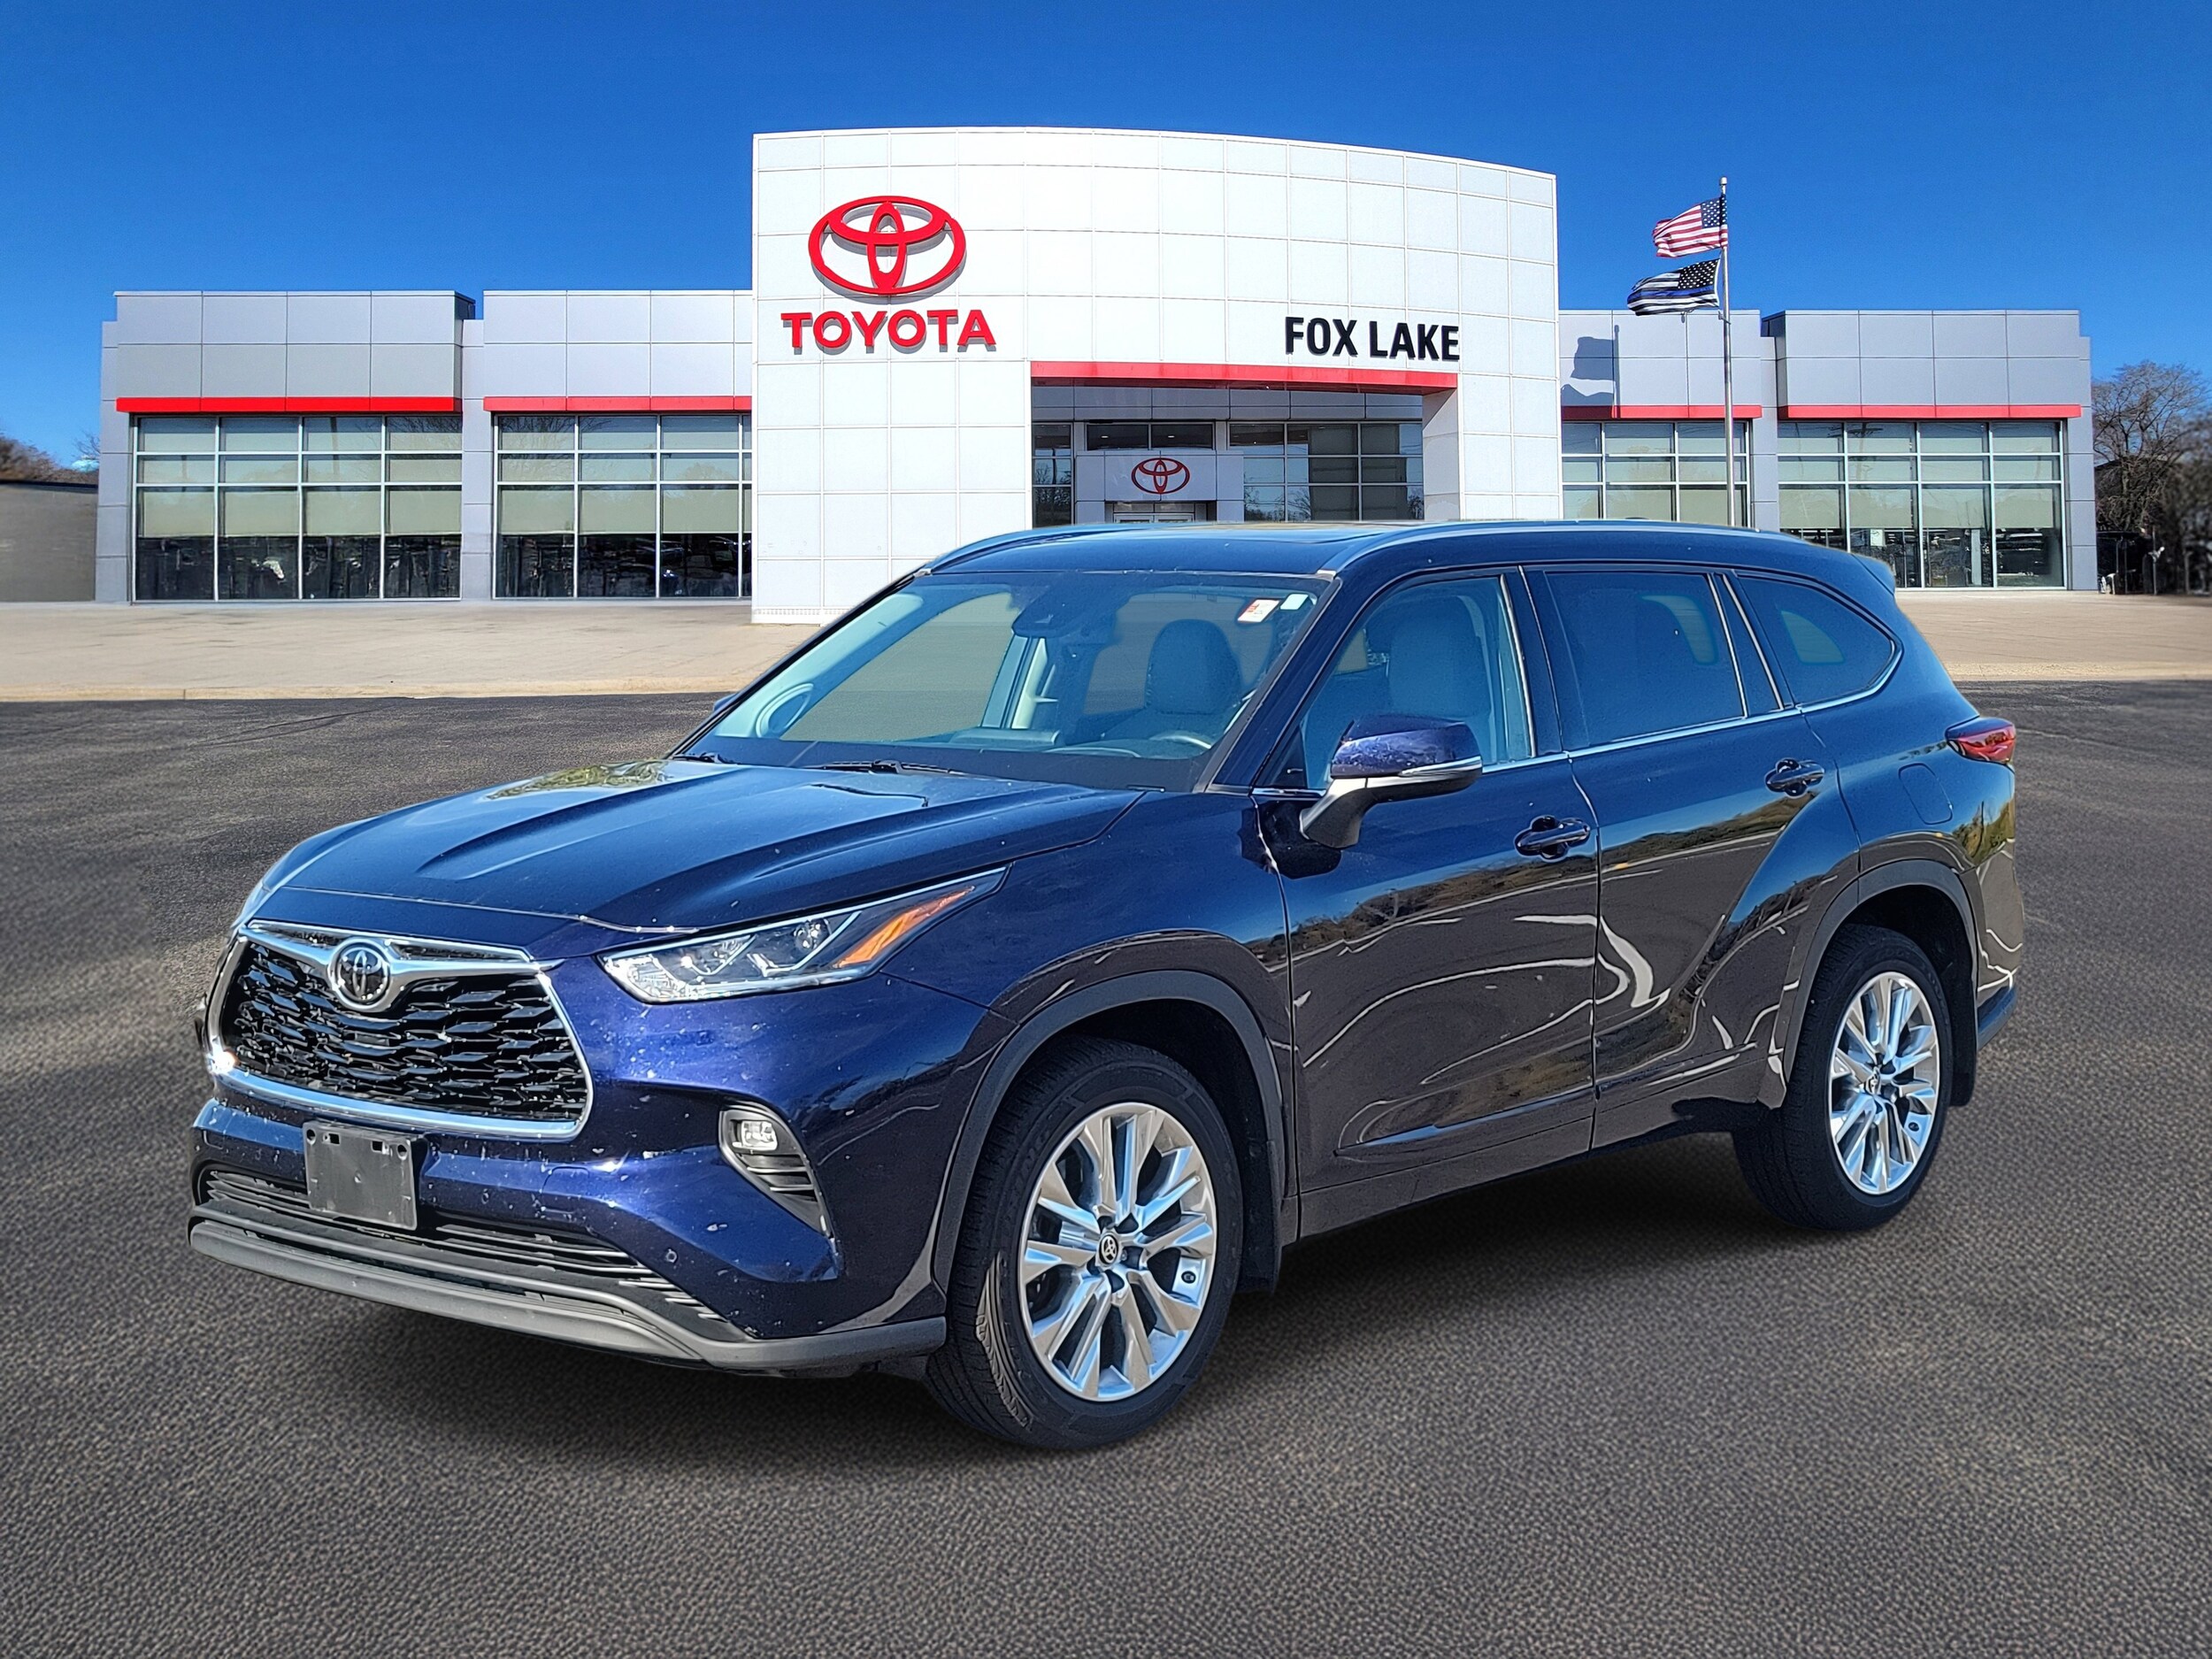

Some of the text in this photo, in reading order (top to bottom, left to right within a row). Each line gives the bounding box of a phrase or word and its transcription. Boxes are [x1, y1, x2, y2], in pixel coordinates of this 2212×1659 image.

[781, 309, 996, 350] TOYOTA
[1285, 316, 1460, 362] FOX LAKE
